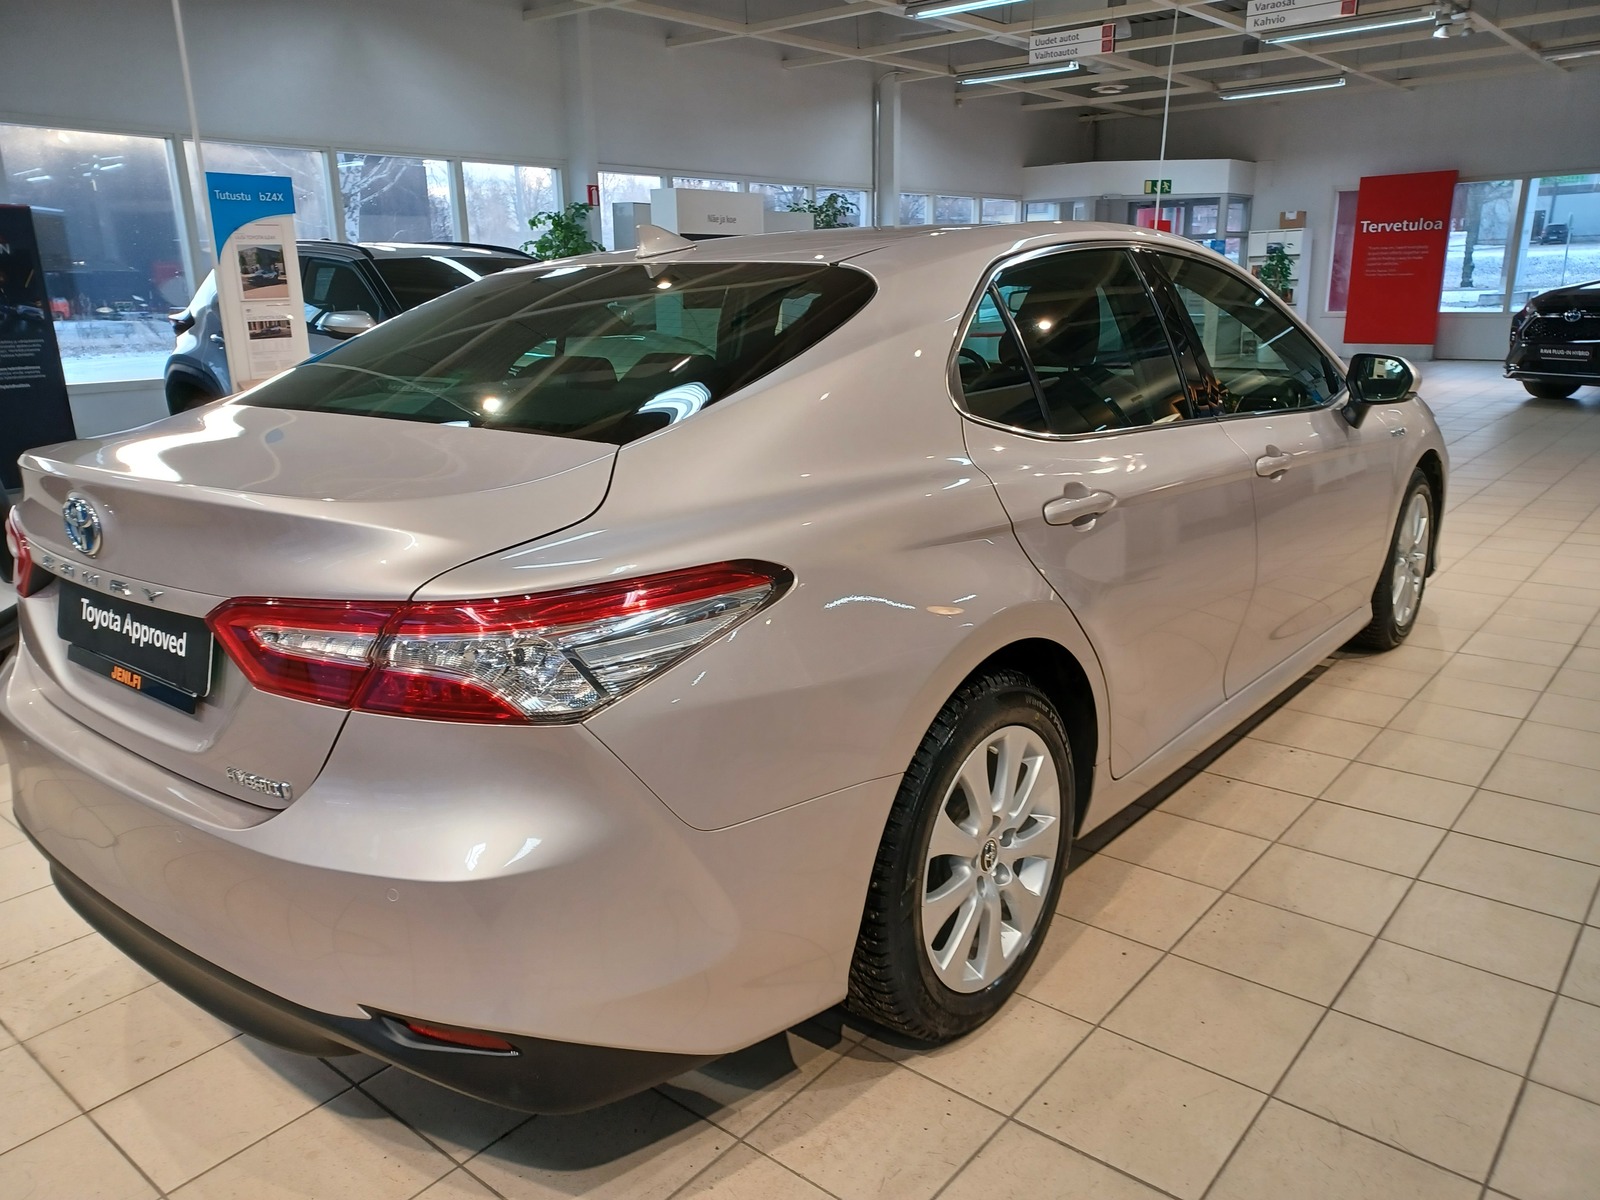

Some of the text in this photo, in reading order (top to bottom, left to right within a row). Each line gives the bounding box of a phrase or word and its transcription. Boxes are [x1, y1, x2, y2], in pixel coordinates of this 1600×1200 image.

[1254, 0, 1296, 11] Varaosat
[1253, 15, 1286, 27] Kahvio
[1034, 33, 1080, 47] Uudet autot
[1034, 47, 1079, 60] Vaihtoautot
[214, 189, 284, 202] Tutustu bZ4X
[707, 214, 719, 223] Näe
[726, 215, 737, 224] koe
[1360, 217, 1444, 233] Tervetuloa
[80, 597, 188, 658] Toyota Approved
